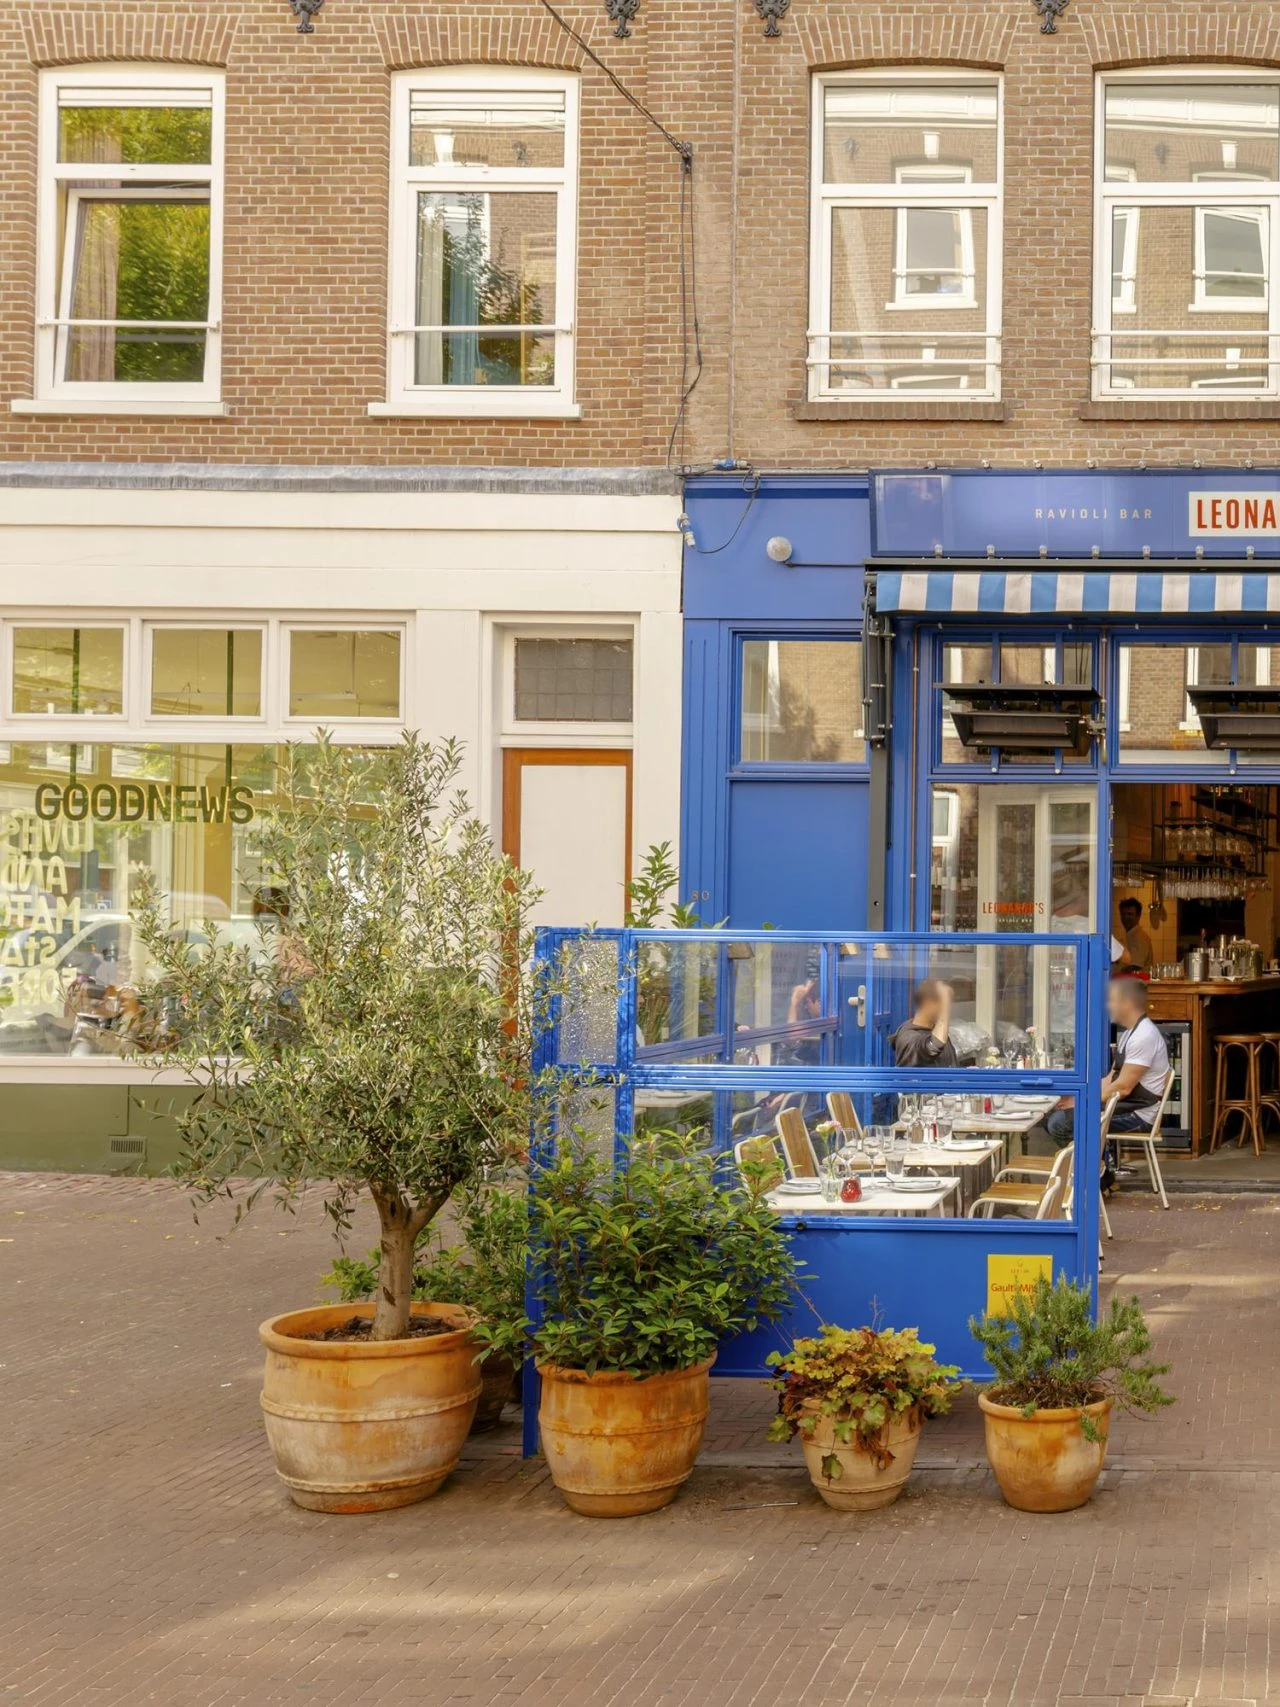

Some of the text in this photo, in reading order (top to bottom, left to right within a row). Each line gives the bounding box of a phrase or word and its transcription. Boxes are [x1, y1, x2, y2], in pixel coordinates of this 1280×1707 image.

[1034, 508, 1153, 519] RAVIOLI BAR
[34, 782, 255, 825] GOODNEWS
